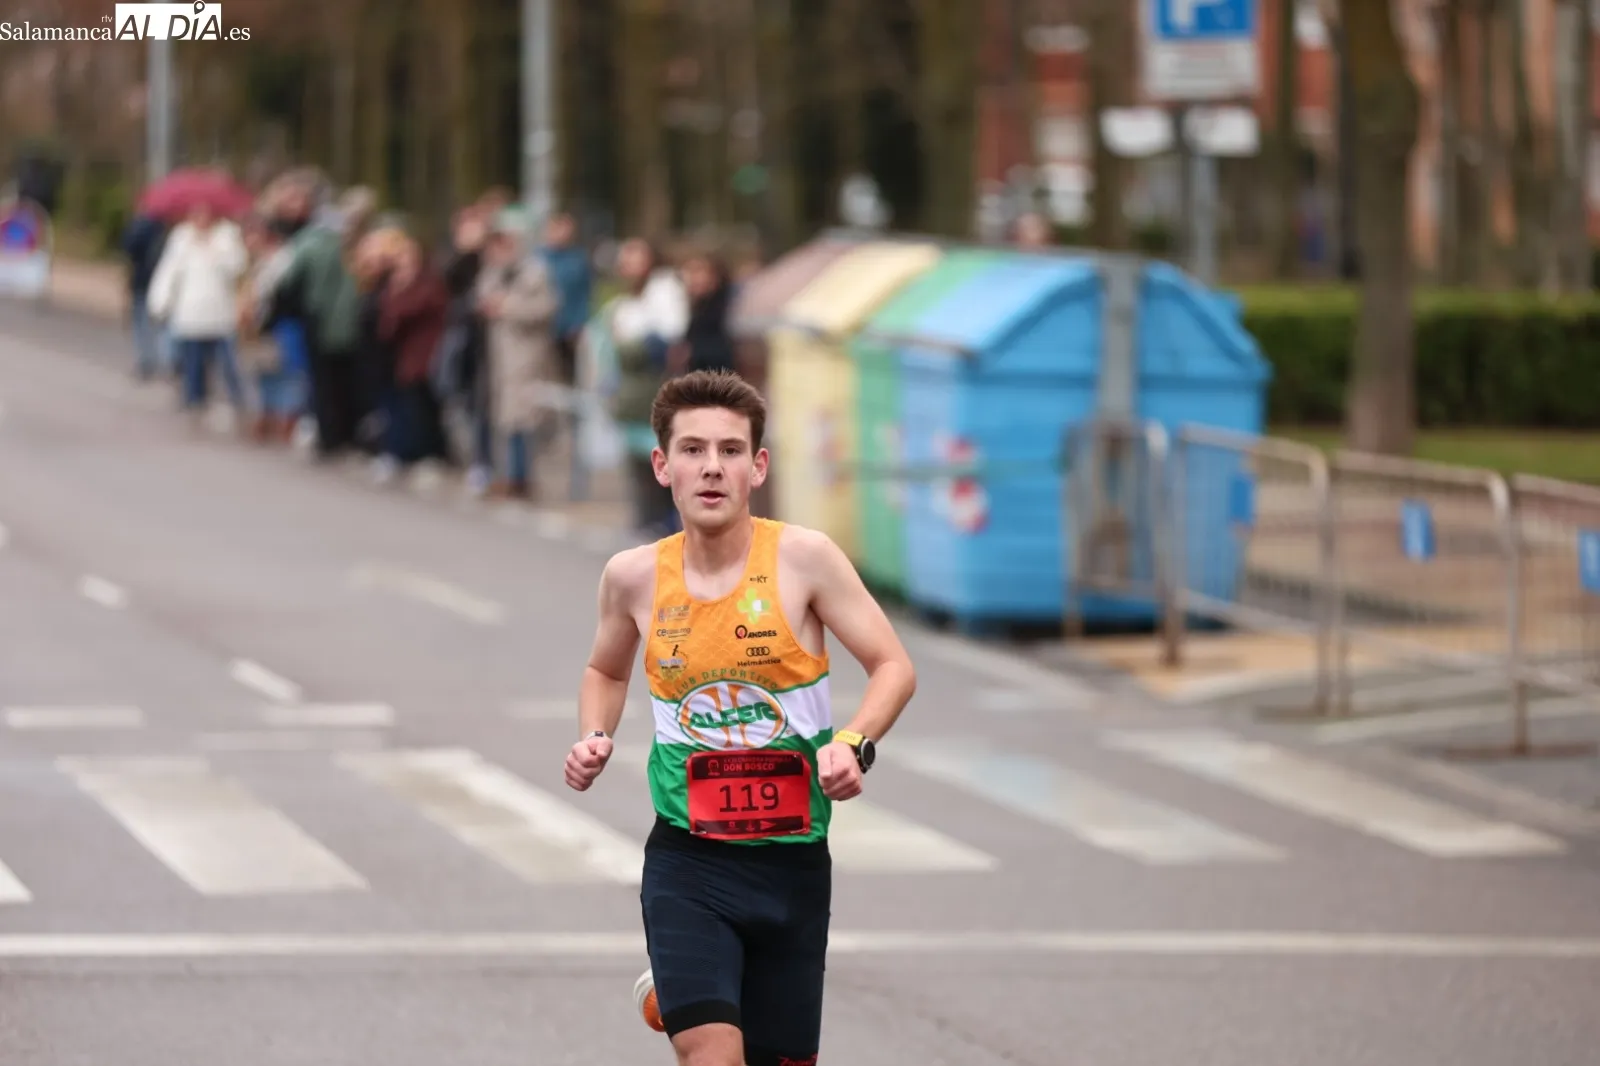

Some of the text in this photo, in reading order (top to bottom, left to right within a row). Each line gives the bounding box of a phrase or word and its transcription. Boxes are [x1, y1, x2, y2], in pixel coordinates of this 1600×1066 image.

[701, 667, 779, 689] DEPORTIVO
[723, 762, 775, 772] DON BOSCO
[719, 782, 780, 813] 119
